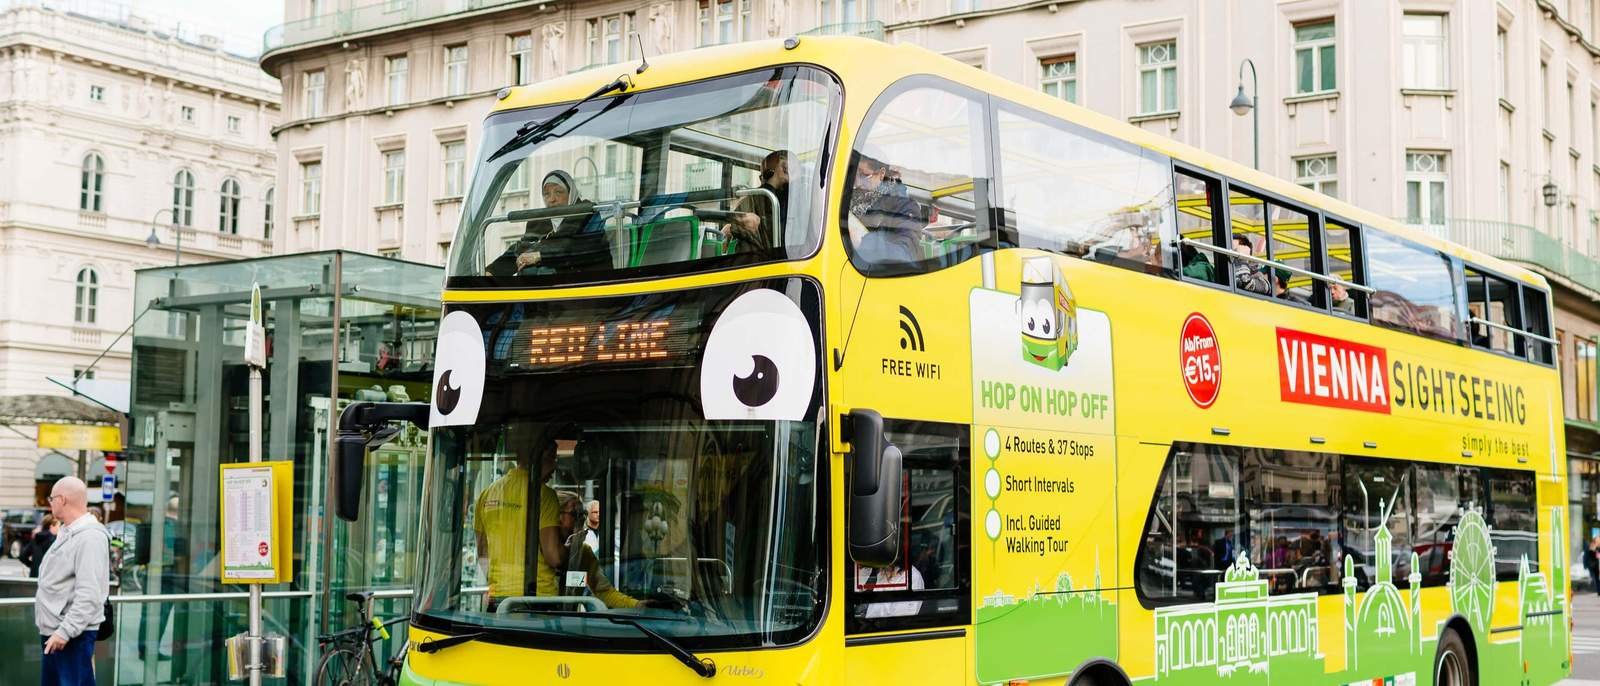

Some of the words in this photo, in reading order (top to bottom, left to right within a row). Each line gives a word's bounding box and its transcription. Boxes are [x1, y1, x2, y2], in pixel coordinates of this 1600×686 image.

[530, 326, 586, 364] RED
[597, 321, 670, 360] LINE
[1184, 335, 1214, 353] Ab/From
[882, 358, 912, 377] FREE
[915, 362, 941, 380] WIFI
[1185, 354, 1220, 385] €15,-
[1280, 337, 1387, 406] VIENNA
[1393, 360, 1527, 425] SIGHTSEEING
[981, 380, 1016, 410] HOP
[1020, 384, 1042, 413] ON
[1046, 388, 1078, 417] HOP
[1081, 392, 1109, 420] OFF
[1005, 436, 1012, 452] 4
[1013, 436, 1046, 454] Routes
[1048, 439, 1056, 455] &
[1057, 439, 1069, 456] 37
[1070, 440, 1095, 461] Stops
[1462, 433, 1493, 457] simply
[1495, 437, 1509, 454] the
[1511, 439, 1530, 457] best
[1005, 475, 1032, 492] Short
[1034, 476, 1075, 493] Intervals
[1006, 514, 1027, 531] Incl.
[1028, 514, 1061, 531] Guided
[1006, 536, 1045, 557] Walking
[1046, 536, 1069, 553] Tour
